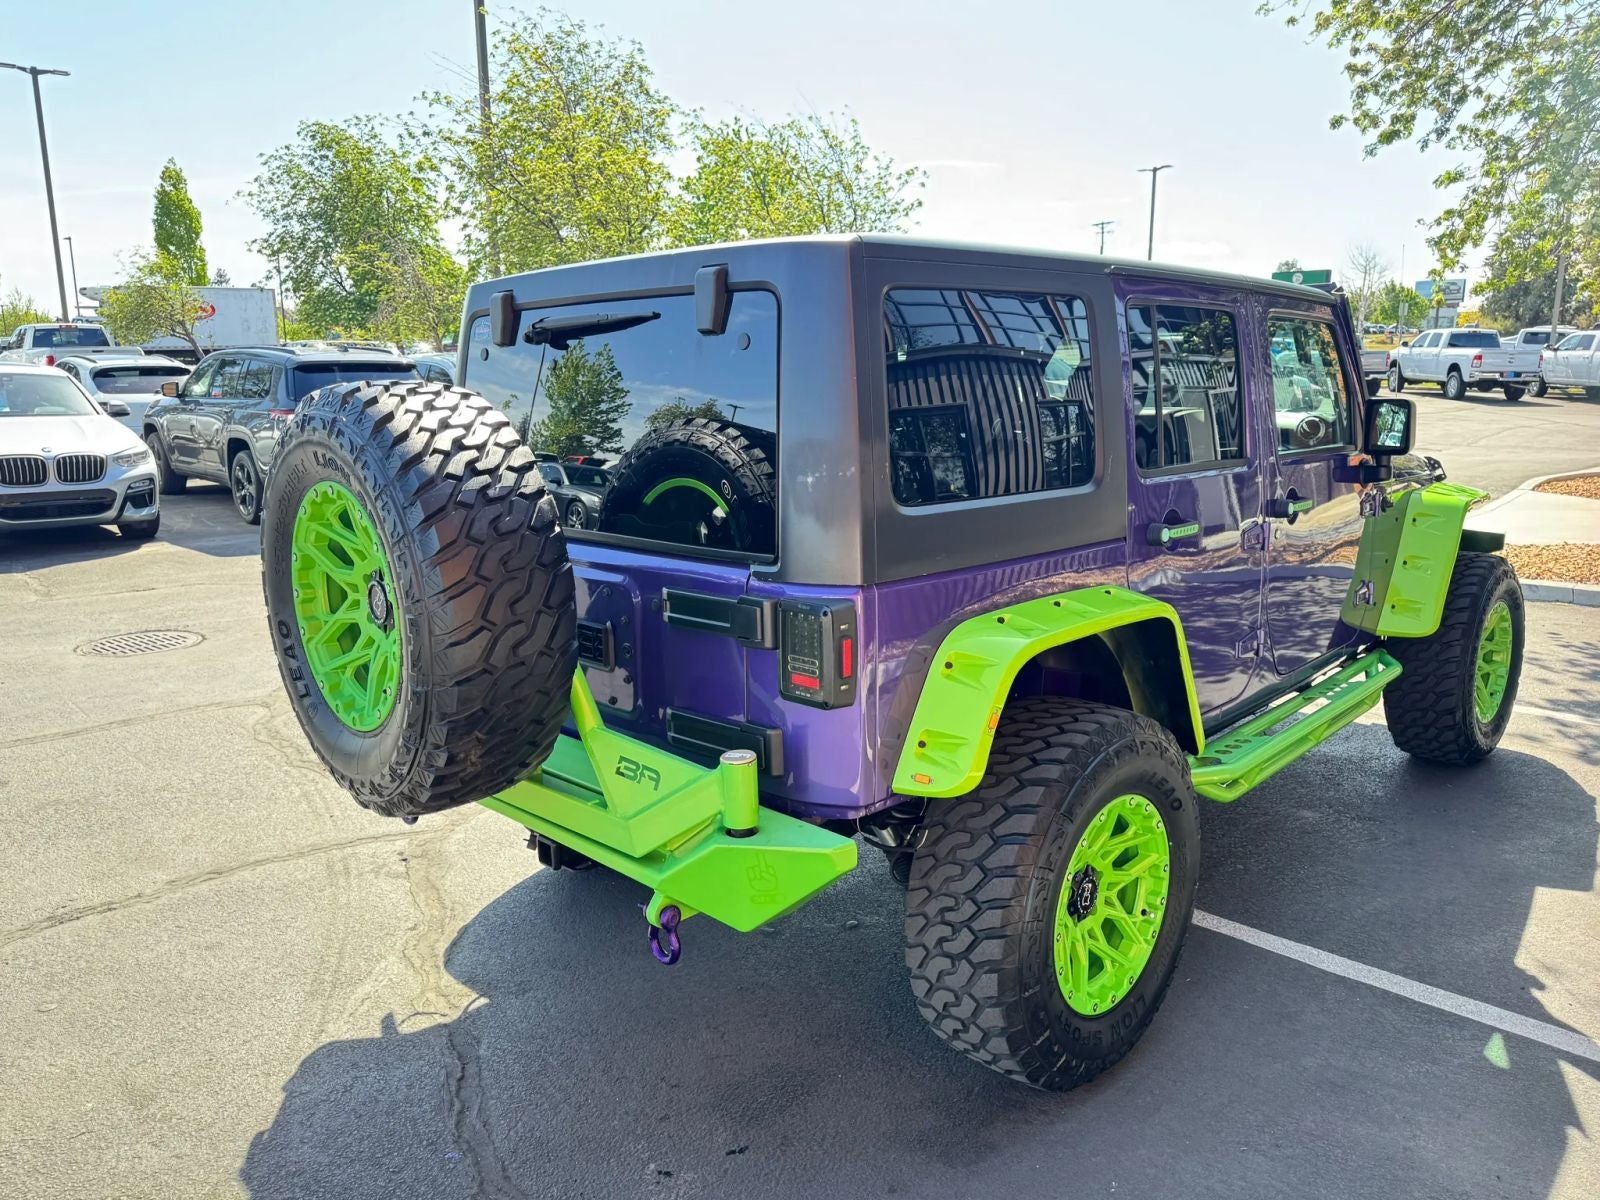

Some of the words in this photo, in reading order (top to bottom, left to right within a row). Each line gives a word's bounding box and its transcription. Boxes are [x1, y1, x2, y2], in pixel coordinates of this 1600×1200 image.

[278, 620, 312, 699] LEAO
[1145, 771, 1183, 811] LEAO
[1110, 995, 1146, 1043] LION
